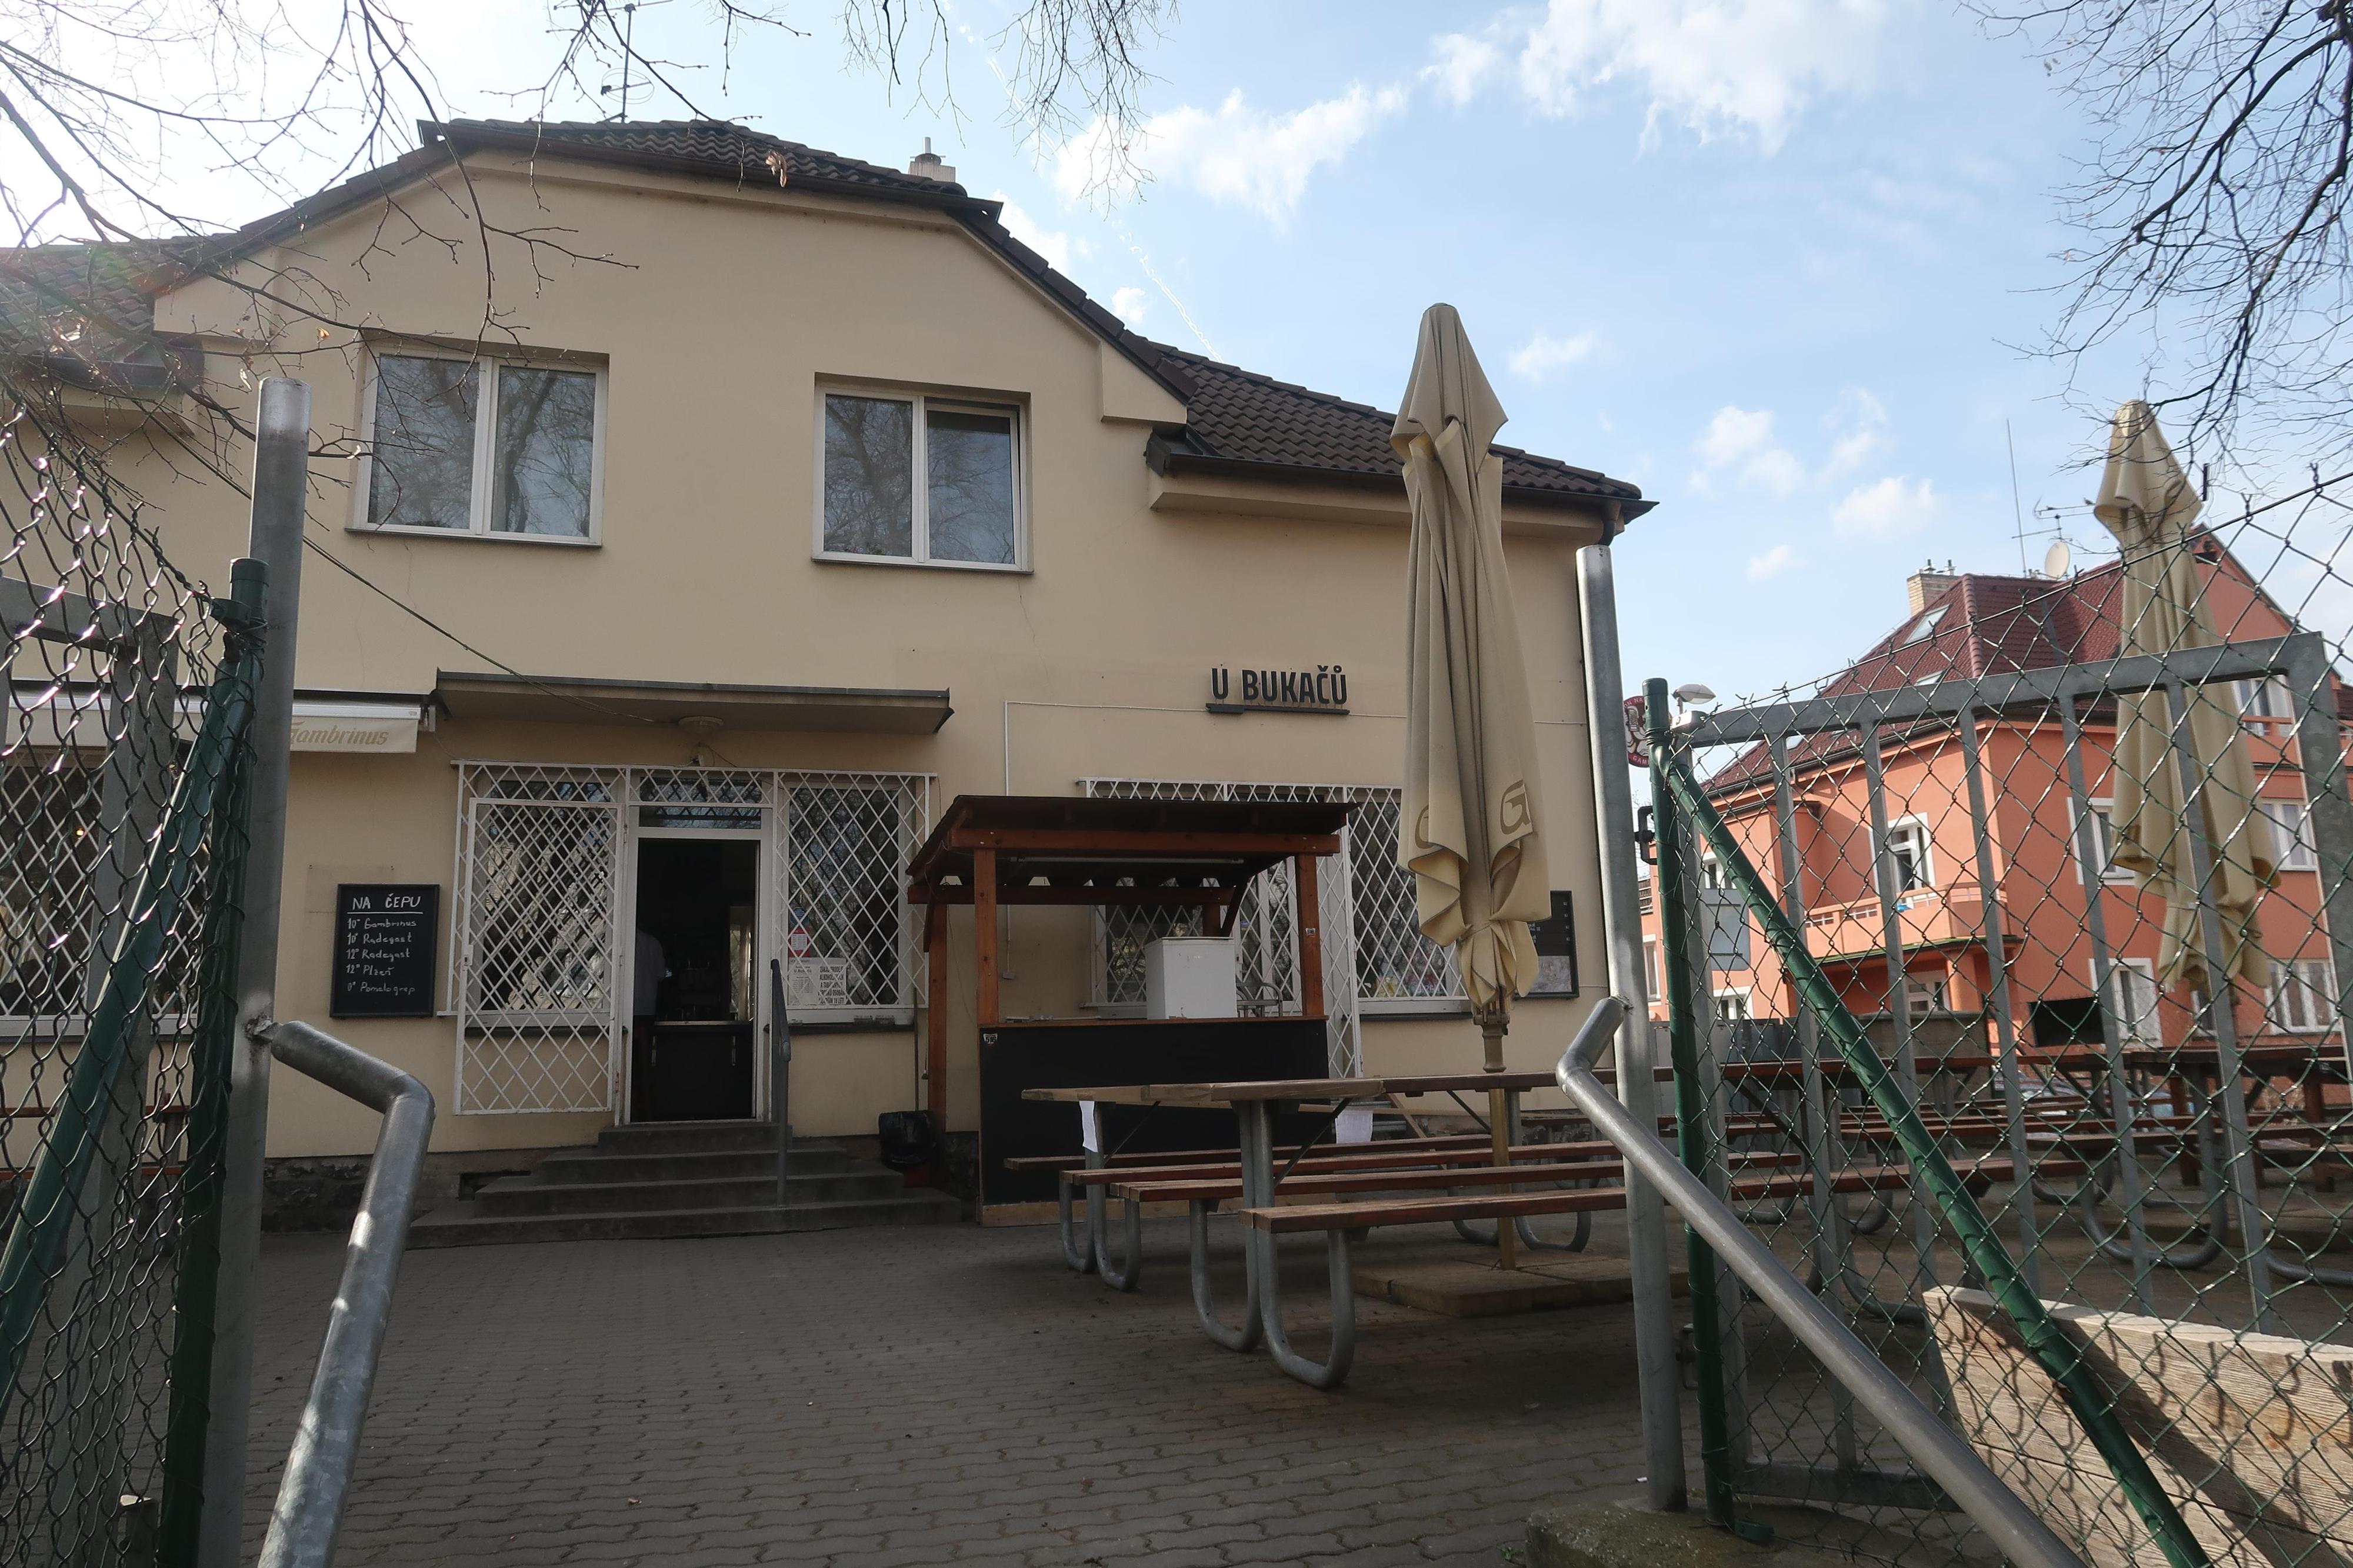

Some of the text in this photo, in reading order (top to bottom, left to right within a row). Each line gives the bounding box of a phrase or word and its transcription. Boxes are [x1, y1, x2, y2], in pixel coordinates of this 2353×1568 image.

[1211, 665, 1348, 705] U BUKAČŮ
[352, 893, 422, 910] NA ČEPU
[364, 918, 417, 930] Gambrinus
[363, 932, 412, 945] Radegast
[361, 948, 410, 962] Radegast
